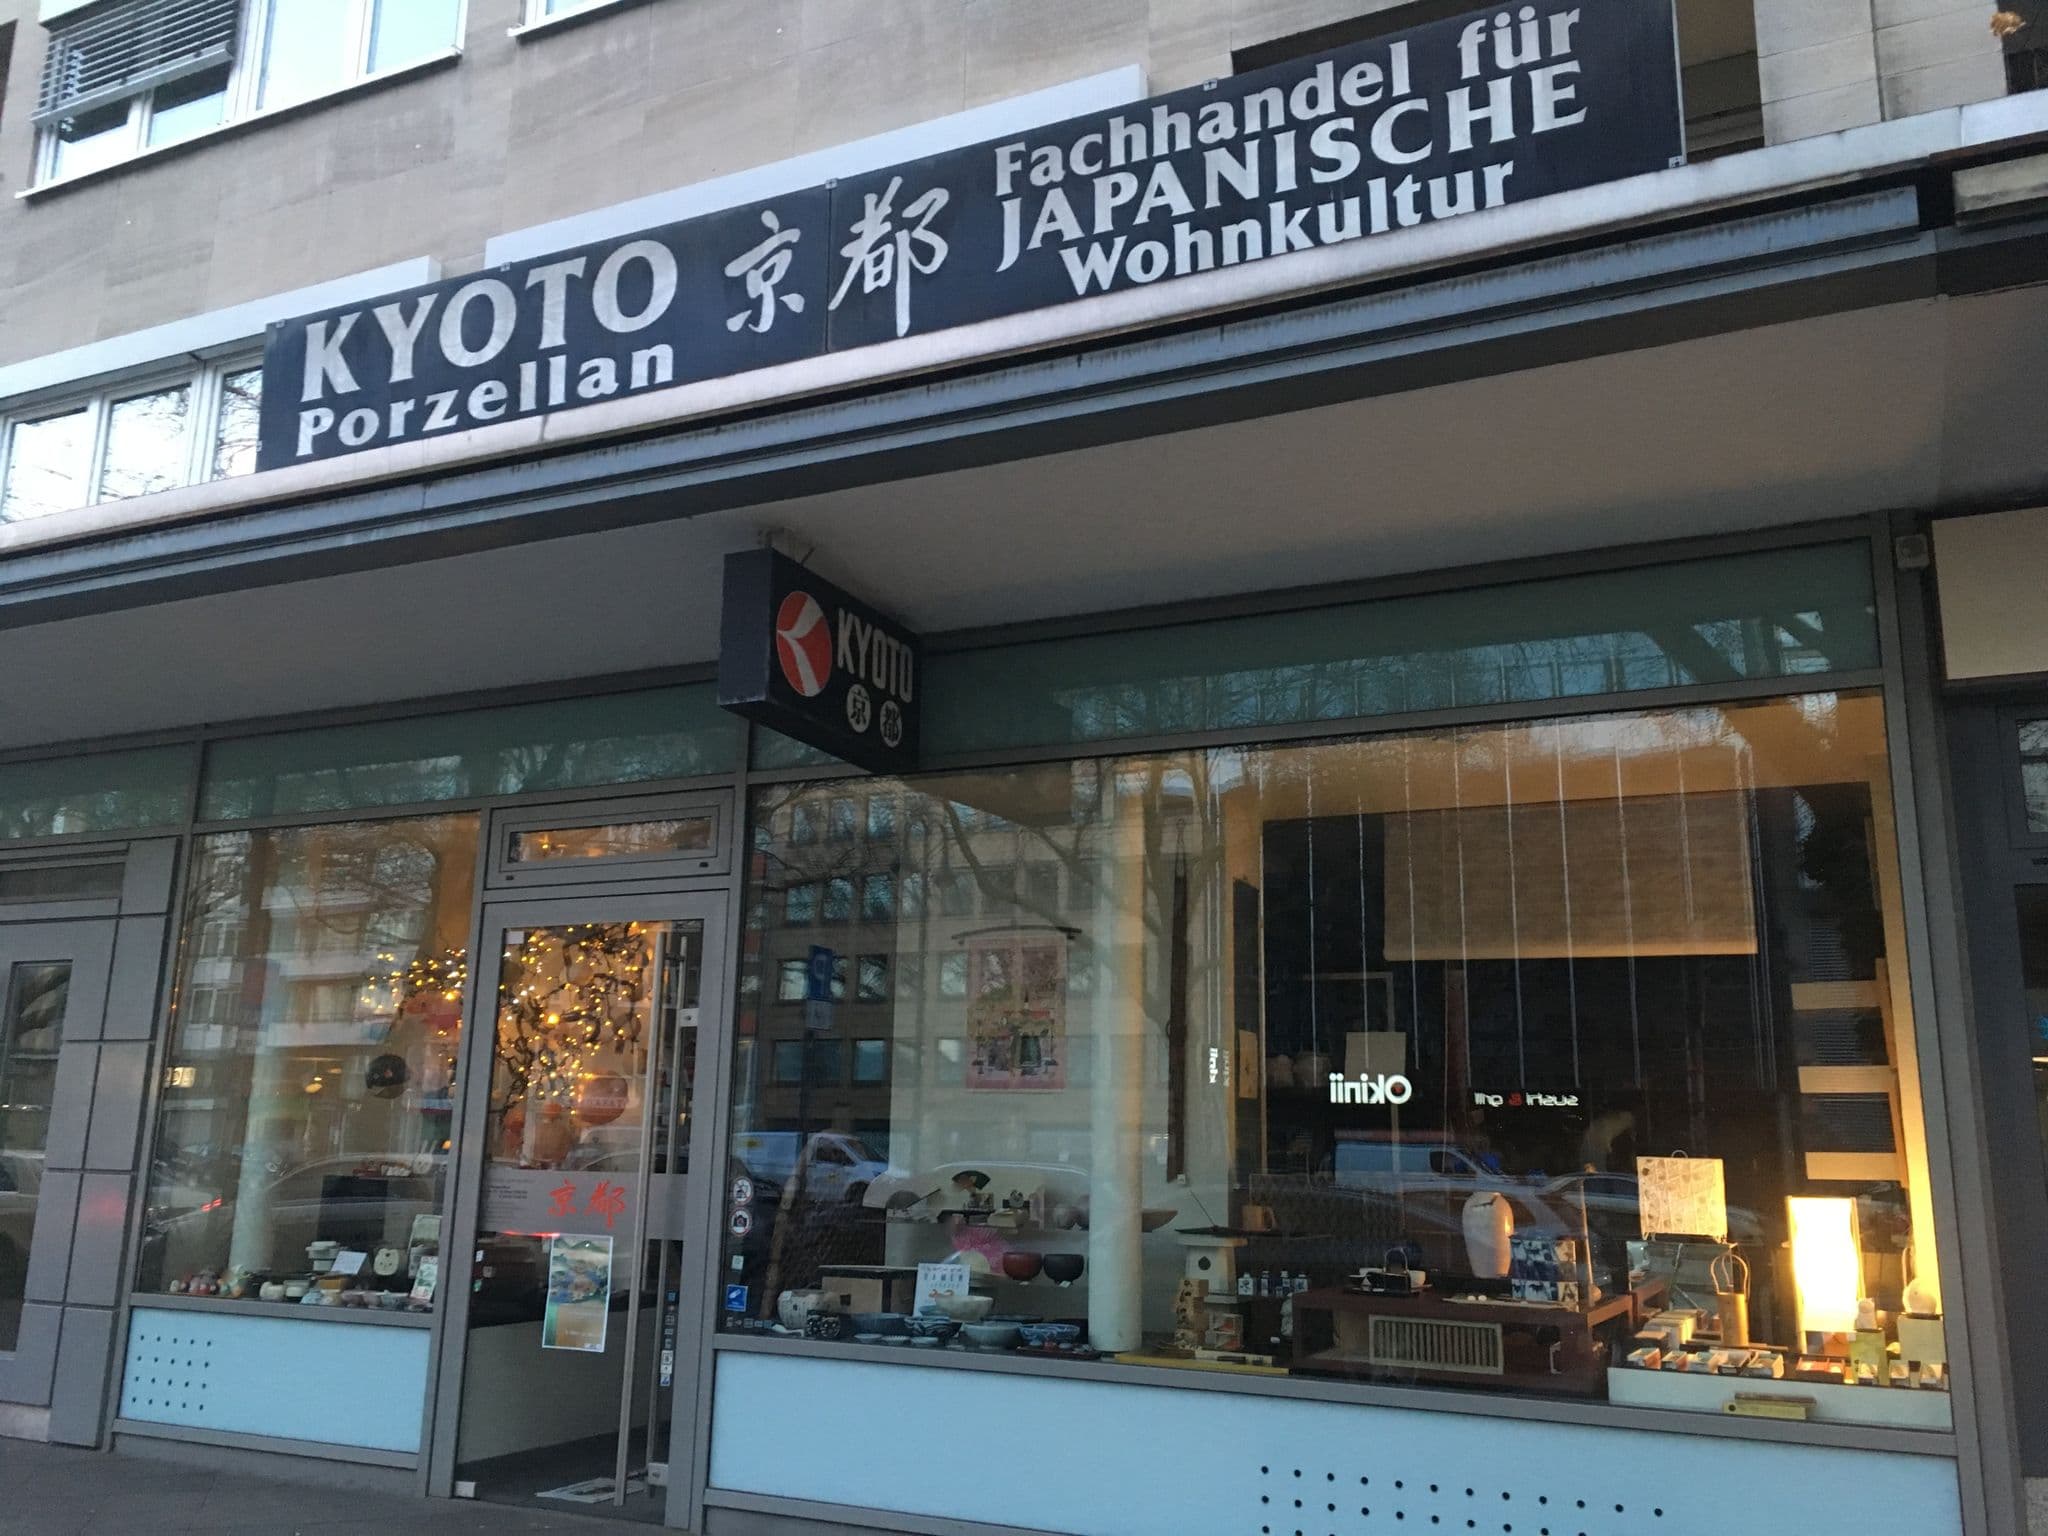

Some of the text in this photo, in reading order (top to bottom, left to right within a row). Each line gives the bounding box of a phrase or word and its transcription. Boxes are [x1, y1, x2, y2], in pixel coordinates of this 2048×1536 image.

[995, 5, 1581, 196] Fachhandel für
[996, 60, 1588, 273] JAPANISCHE
[725, 176, 949, 337] 京都
[1059, 160, 1515, 297] Wohnkultur
[300, 239, 678, 402] KYOTO
[296, 343, 674, 457] Porzellan
[837, 608, 913, 703] KYOTO
[547, 1178, 626, 1229] 京都
